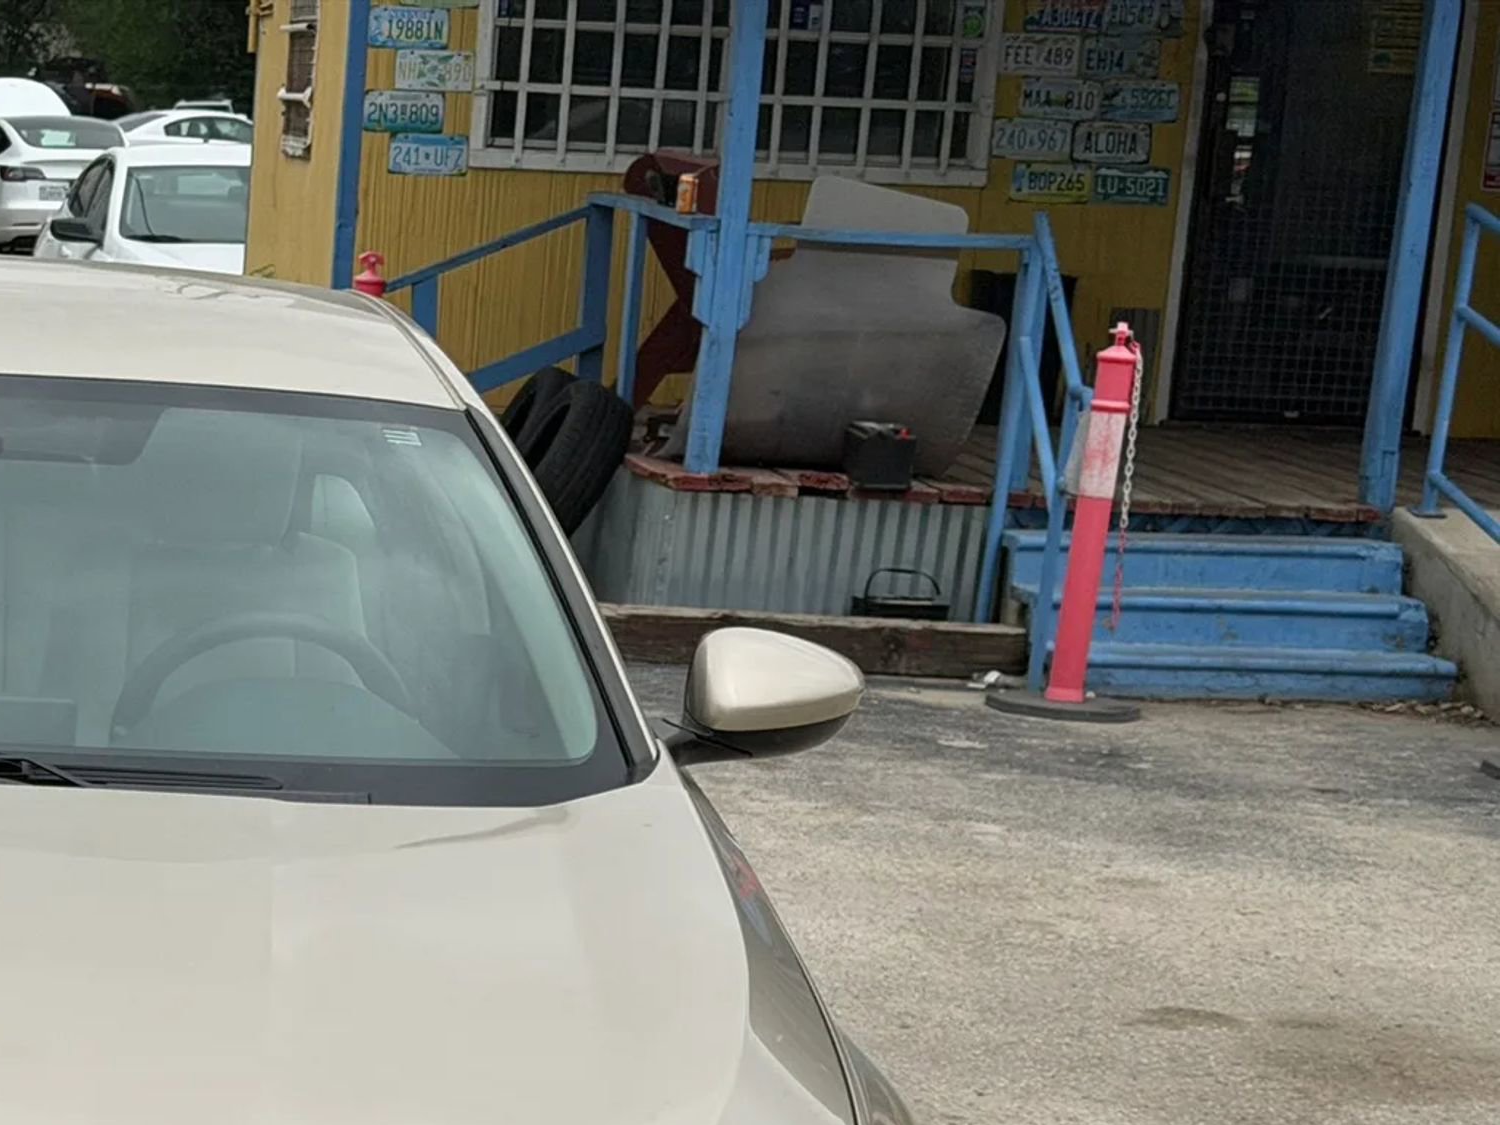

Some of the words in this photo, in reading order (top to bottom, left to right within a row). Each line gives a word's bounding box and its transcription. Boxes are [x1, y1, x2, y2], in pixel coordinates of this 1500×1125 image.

[386, 18, 445, 41] 19881N
[1044, 47, 1075, 66] 489
[368, 102, 398, 125] 2N3
[409, 103, 440, 126] 809
[1083, 131, 1139, 155] ALOHA
[393, 145, 420, 167] 241
